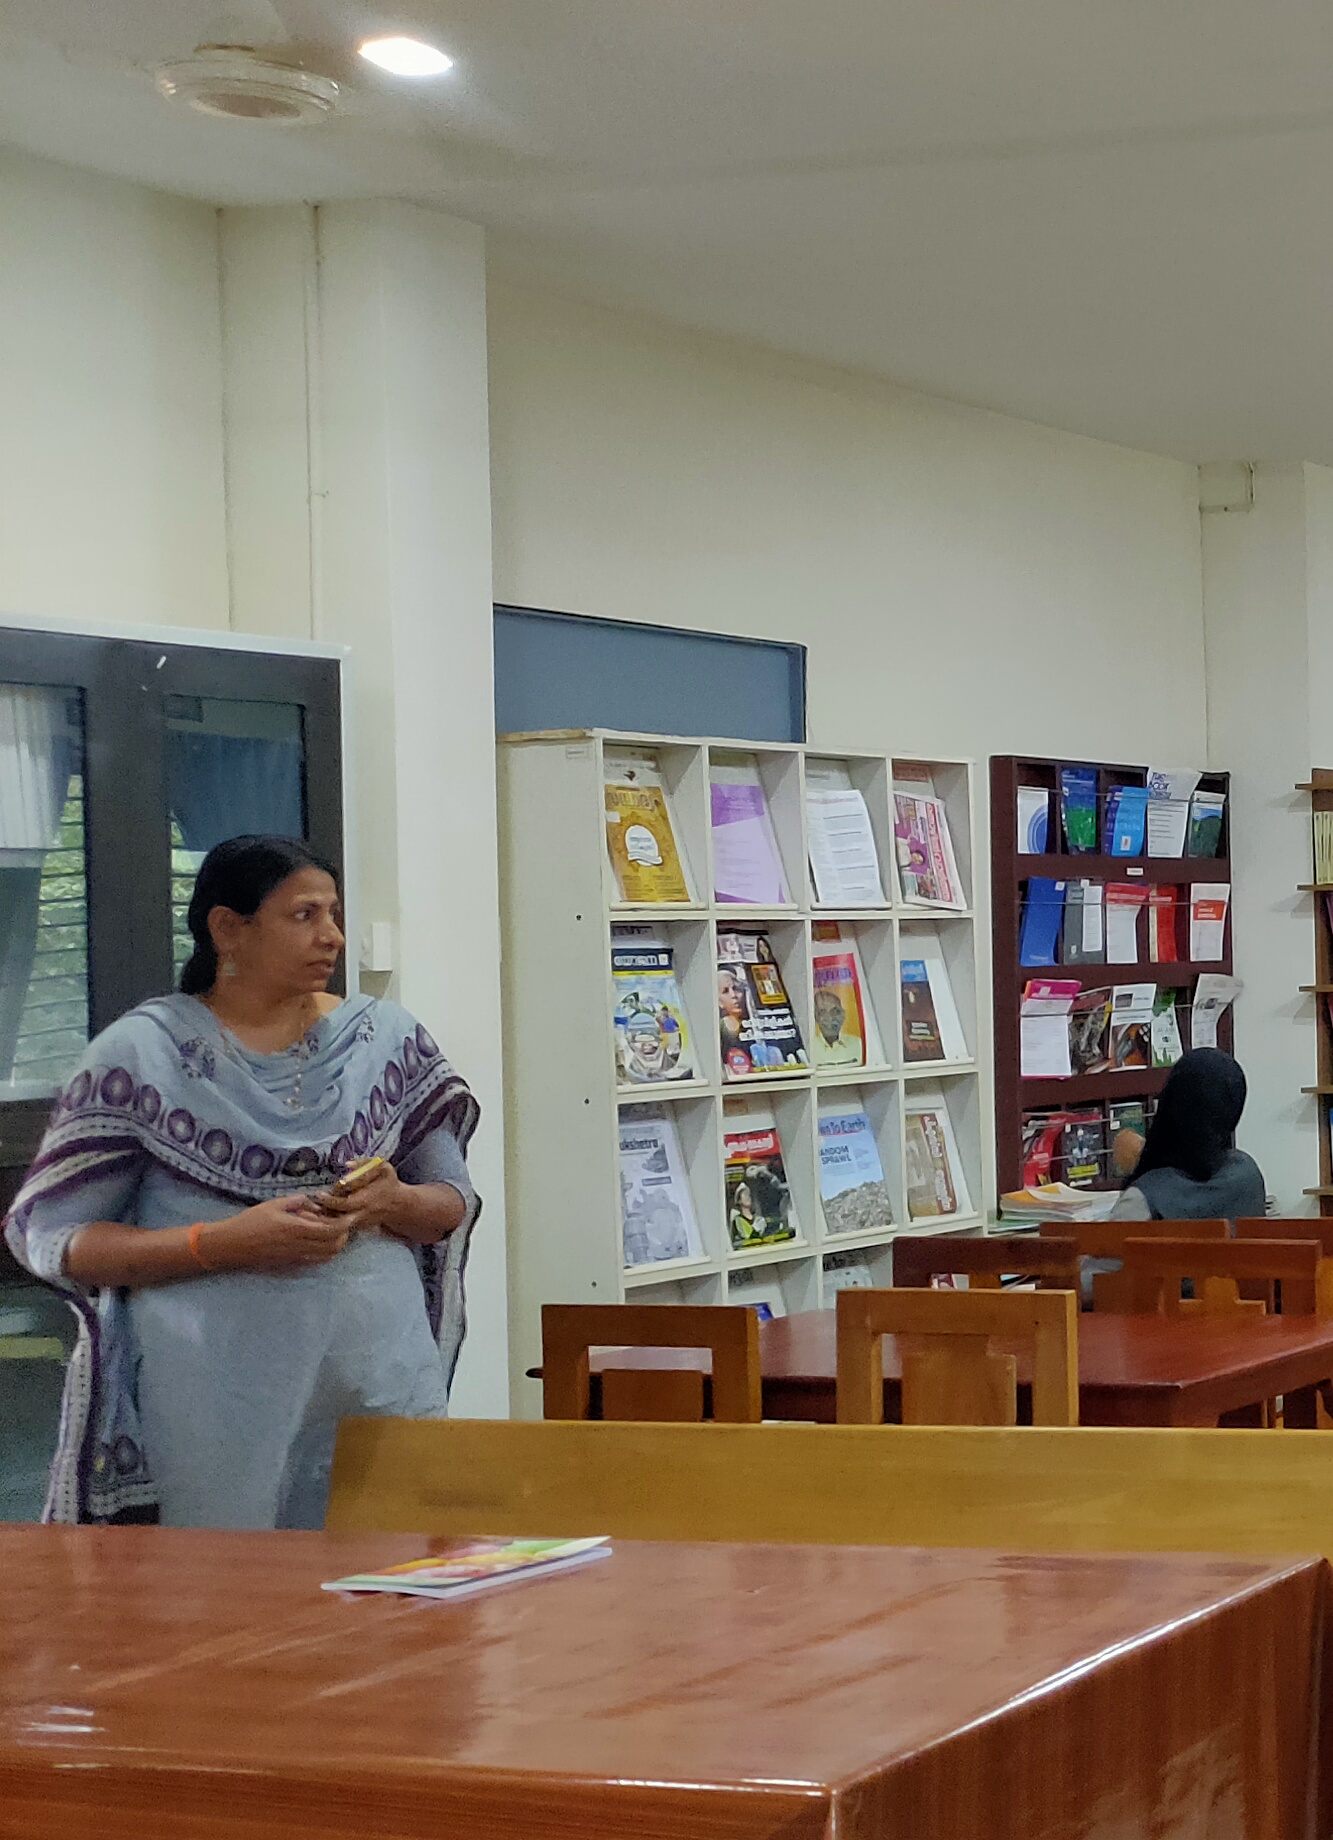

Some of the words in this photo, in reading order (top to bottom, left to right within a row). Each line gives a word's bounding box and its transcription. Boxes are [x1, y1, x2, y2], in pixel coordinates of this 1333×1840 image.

[841, 1118, 866, 1133] Earth
[619, 1138, 659, 1151] ukshetra
[820, 1145, 849, 1156] ANDOM
[821, 1154, 852, 1165] SPRAWL
